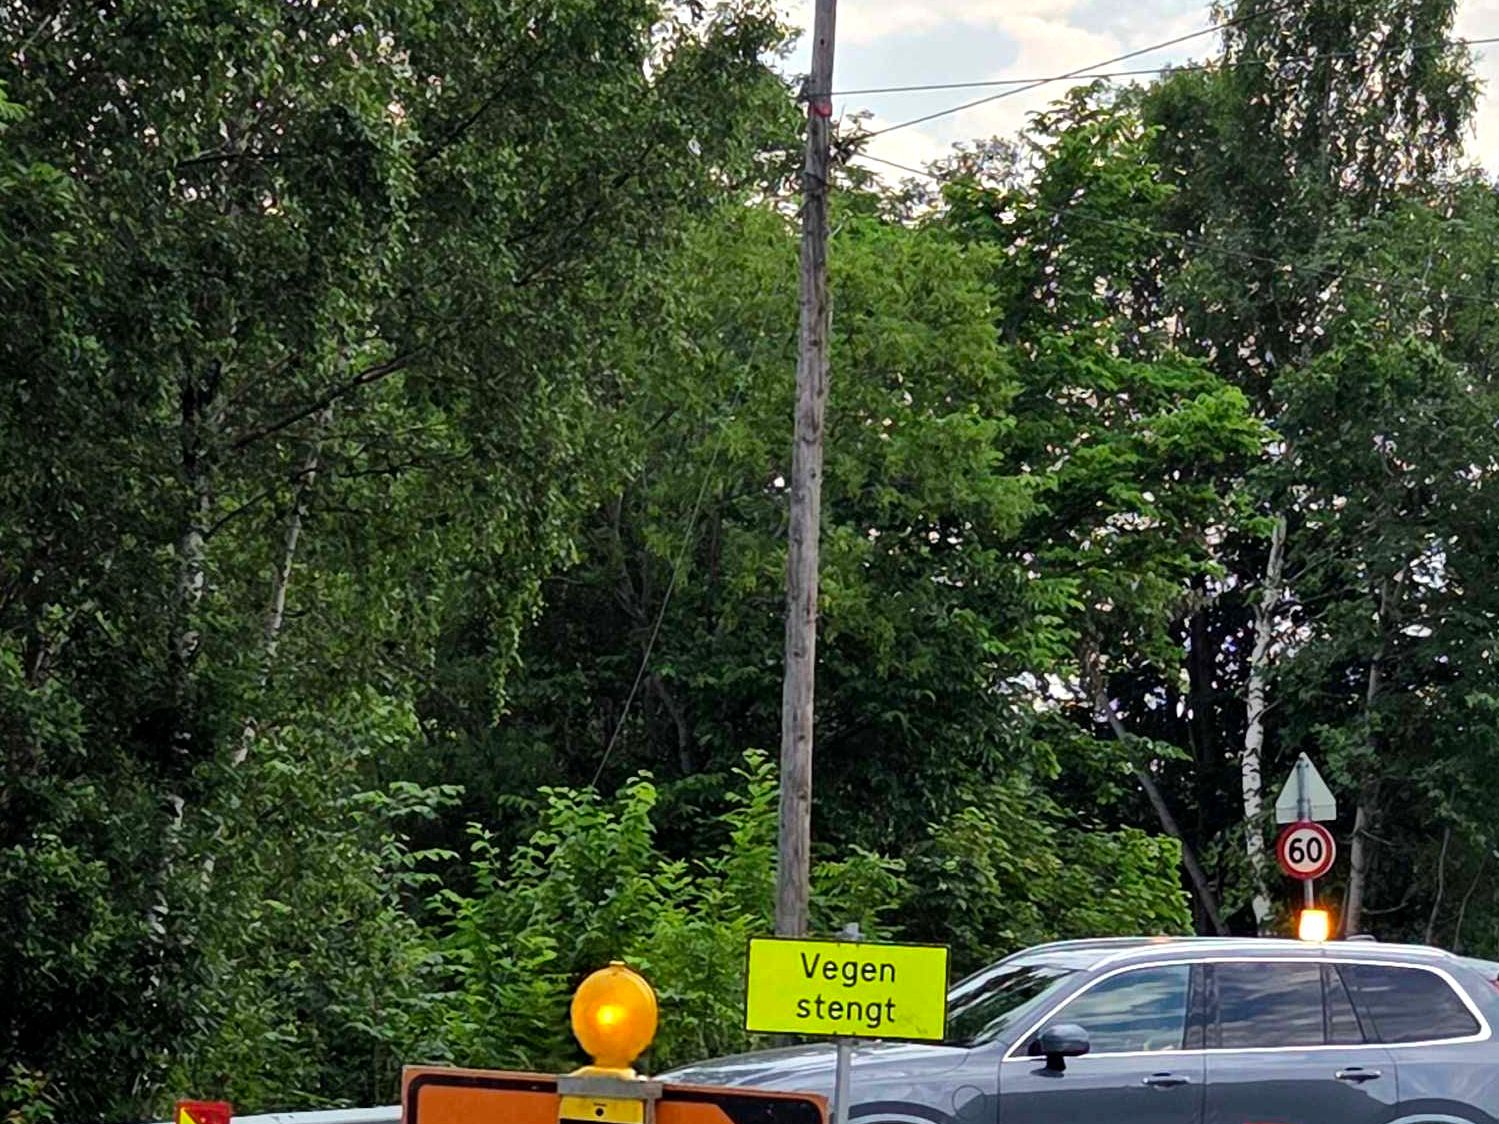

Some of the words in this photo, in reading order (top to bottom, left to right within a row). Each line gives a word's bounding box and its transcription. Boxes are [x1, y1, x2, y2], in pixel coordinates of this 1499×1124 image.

[1289, 837, 1323, 864] 60
[800, 952, 896, 988] Vegen
[796, 993, 897, 1029] stengt
